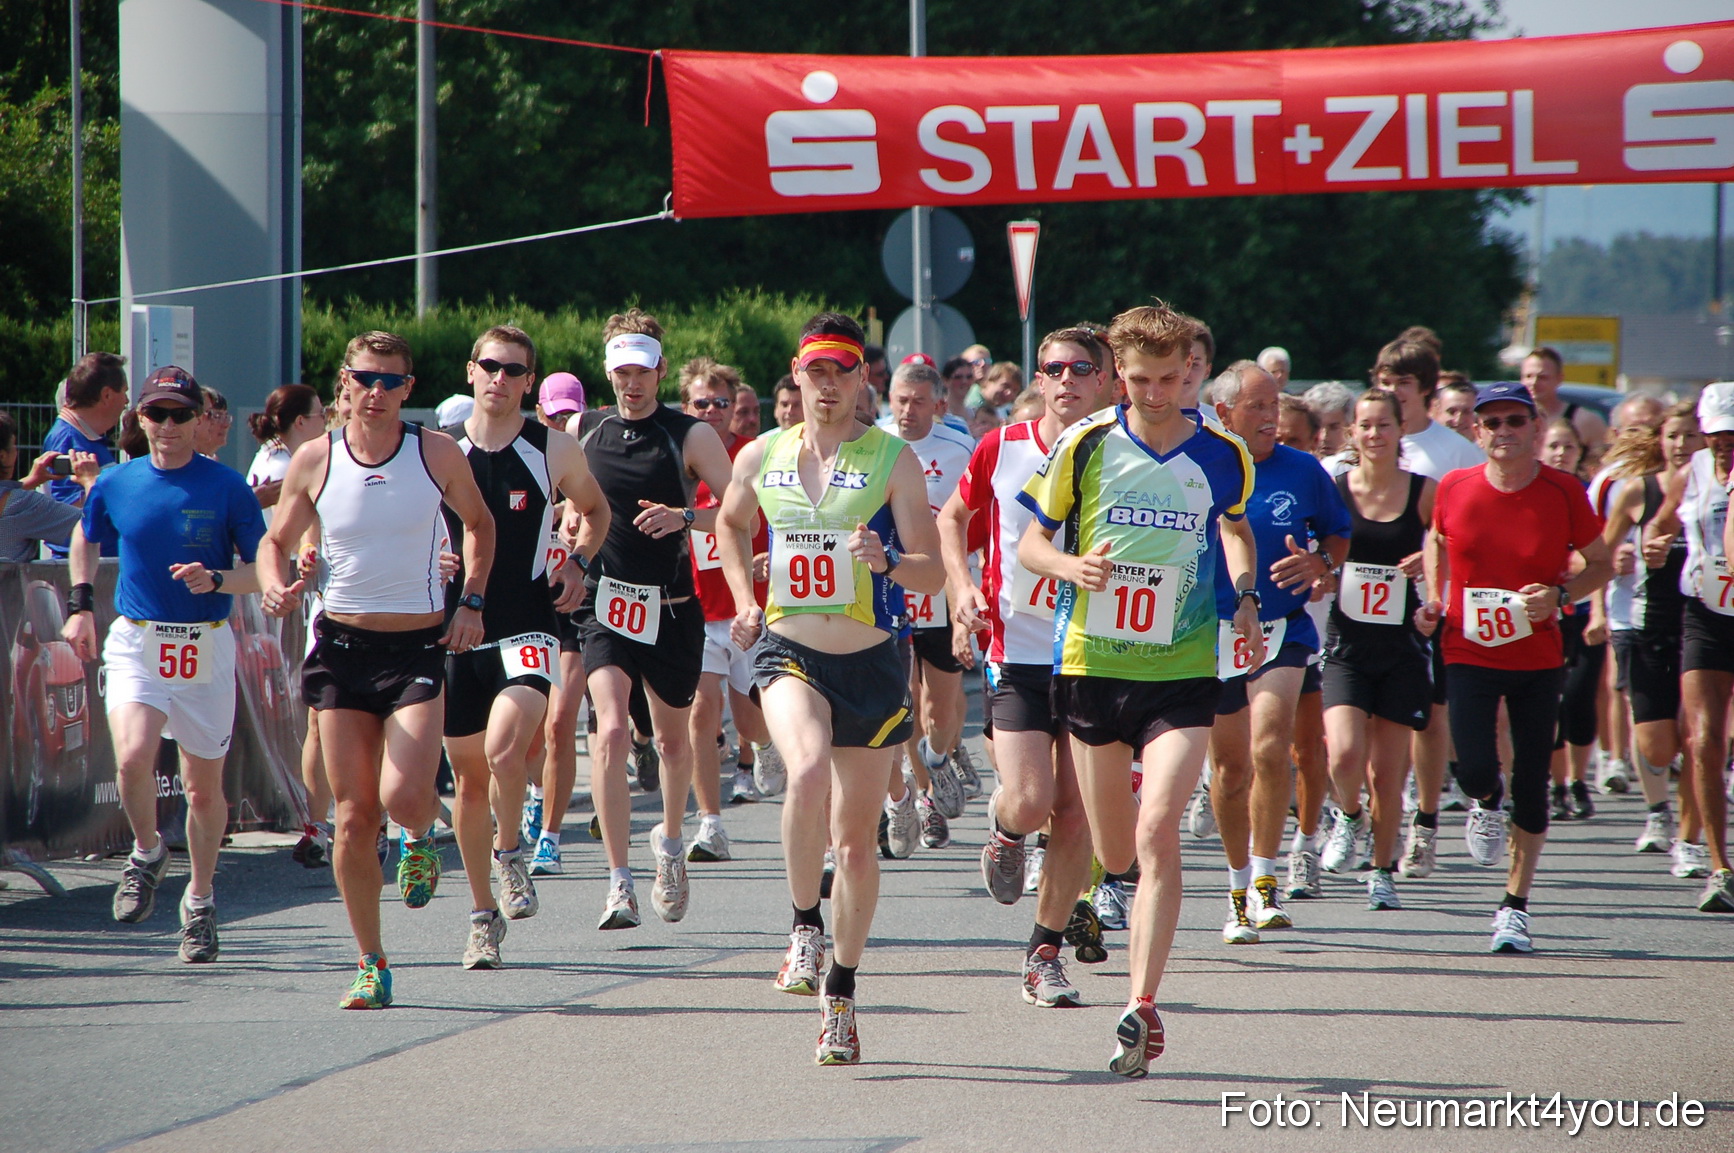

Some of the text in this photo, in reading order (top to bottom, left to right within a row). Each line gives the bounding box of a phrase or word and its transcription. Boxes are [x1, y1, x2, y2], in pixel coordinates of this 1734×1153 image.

[1113, 490, 1172, 508] TEAM
[1107, 506, 1200, 532] BOCK
[785, 533, 820, 543] MEYER
[785, 542, 821, 550] WERBUNG
[609, 581, 636, 594] MEYER
[789, 554, 836, 599] 99
[903, 594, 934, 622] 54
[1114, 585, 1156, 633] 10
[1361, 582, 1390, 616] 12
[155, 625, 188, 634] MEYER
[607, 596, 647, 635] 80
[1477, 607, 1516, 642] 58
[510, 634, 543, 644] MEYER
[159, 643, 199, 679] 56
[519, 645, 551, 676] 81
